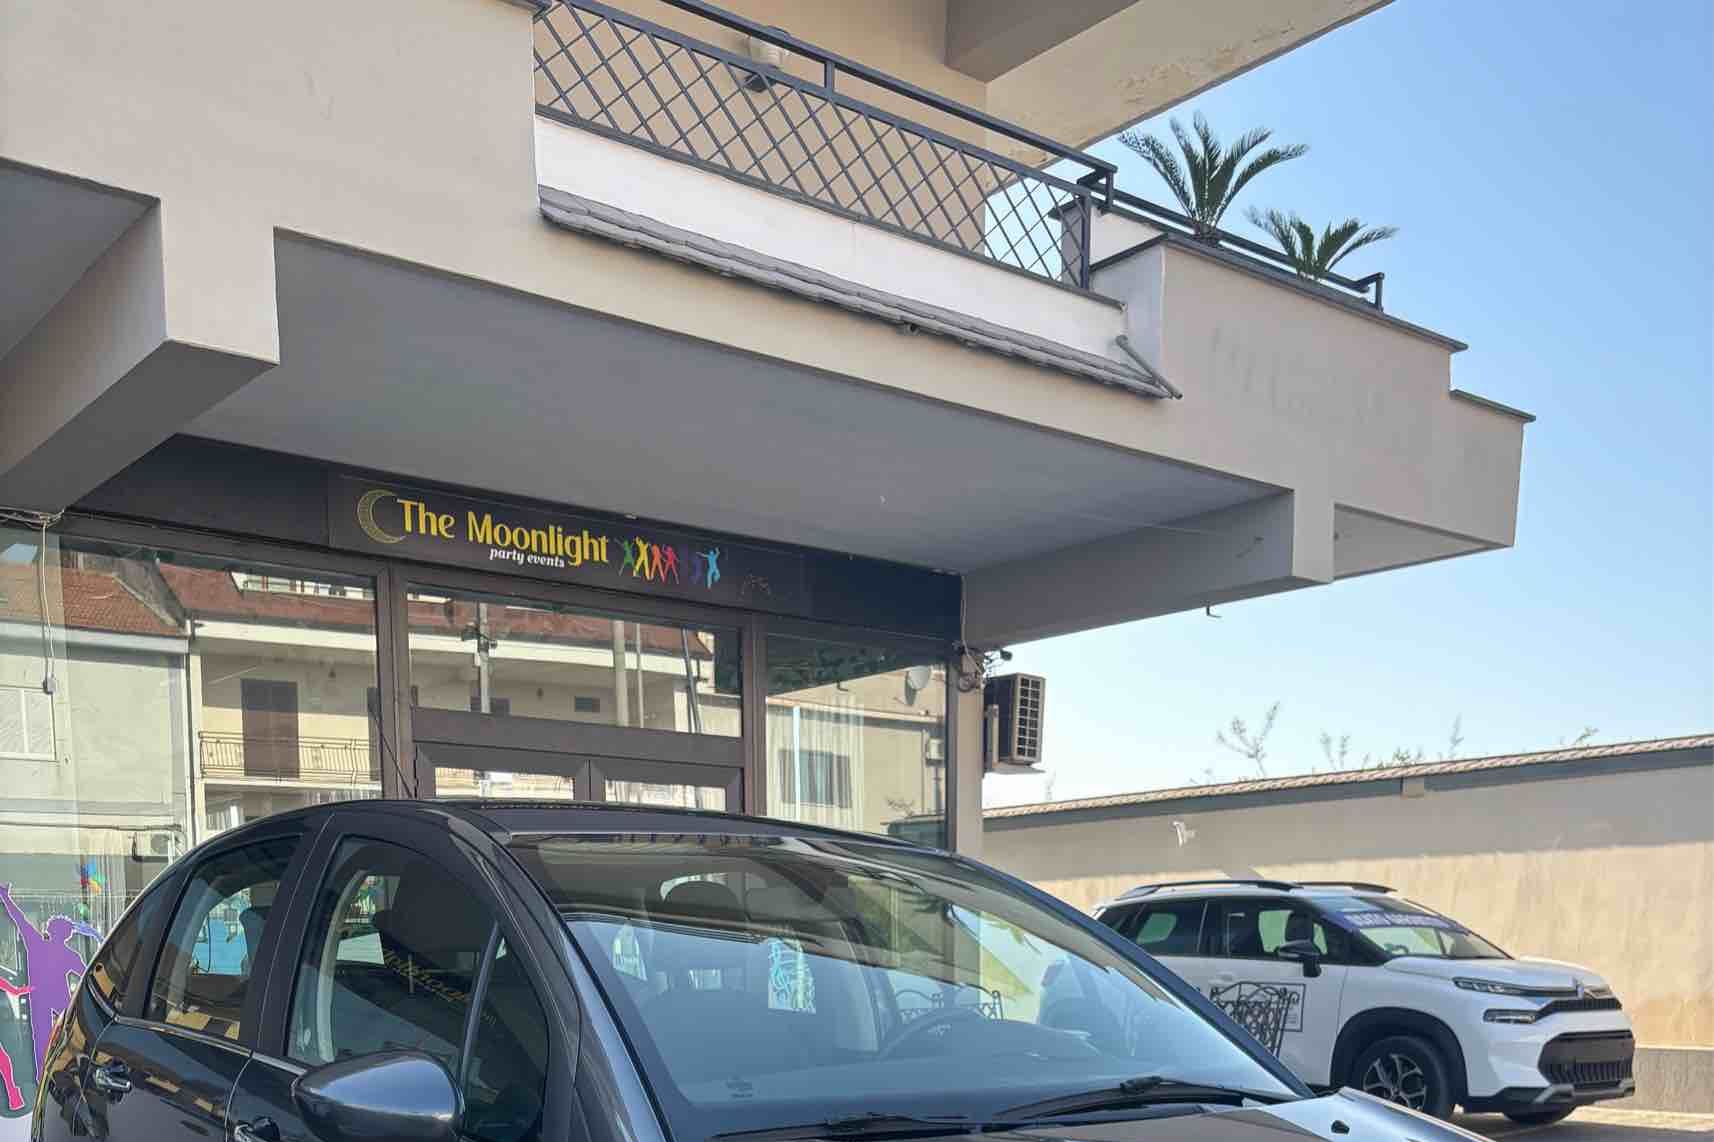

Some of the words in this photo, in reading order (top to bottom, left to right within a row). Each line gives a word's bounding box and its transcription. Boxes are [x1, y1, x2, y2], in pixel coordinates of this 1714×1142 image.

[397, 498, 455, 538] The
[467, 511, 608, 567] Moonlight
[489, 547, 524, 565] party
[527, 554, 565, 568] events
